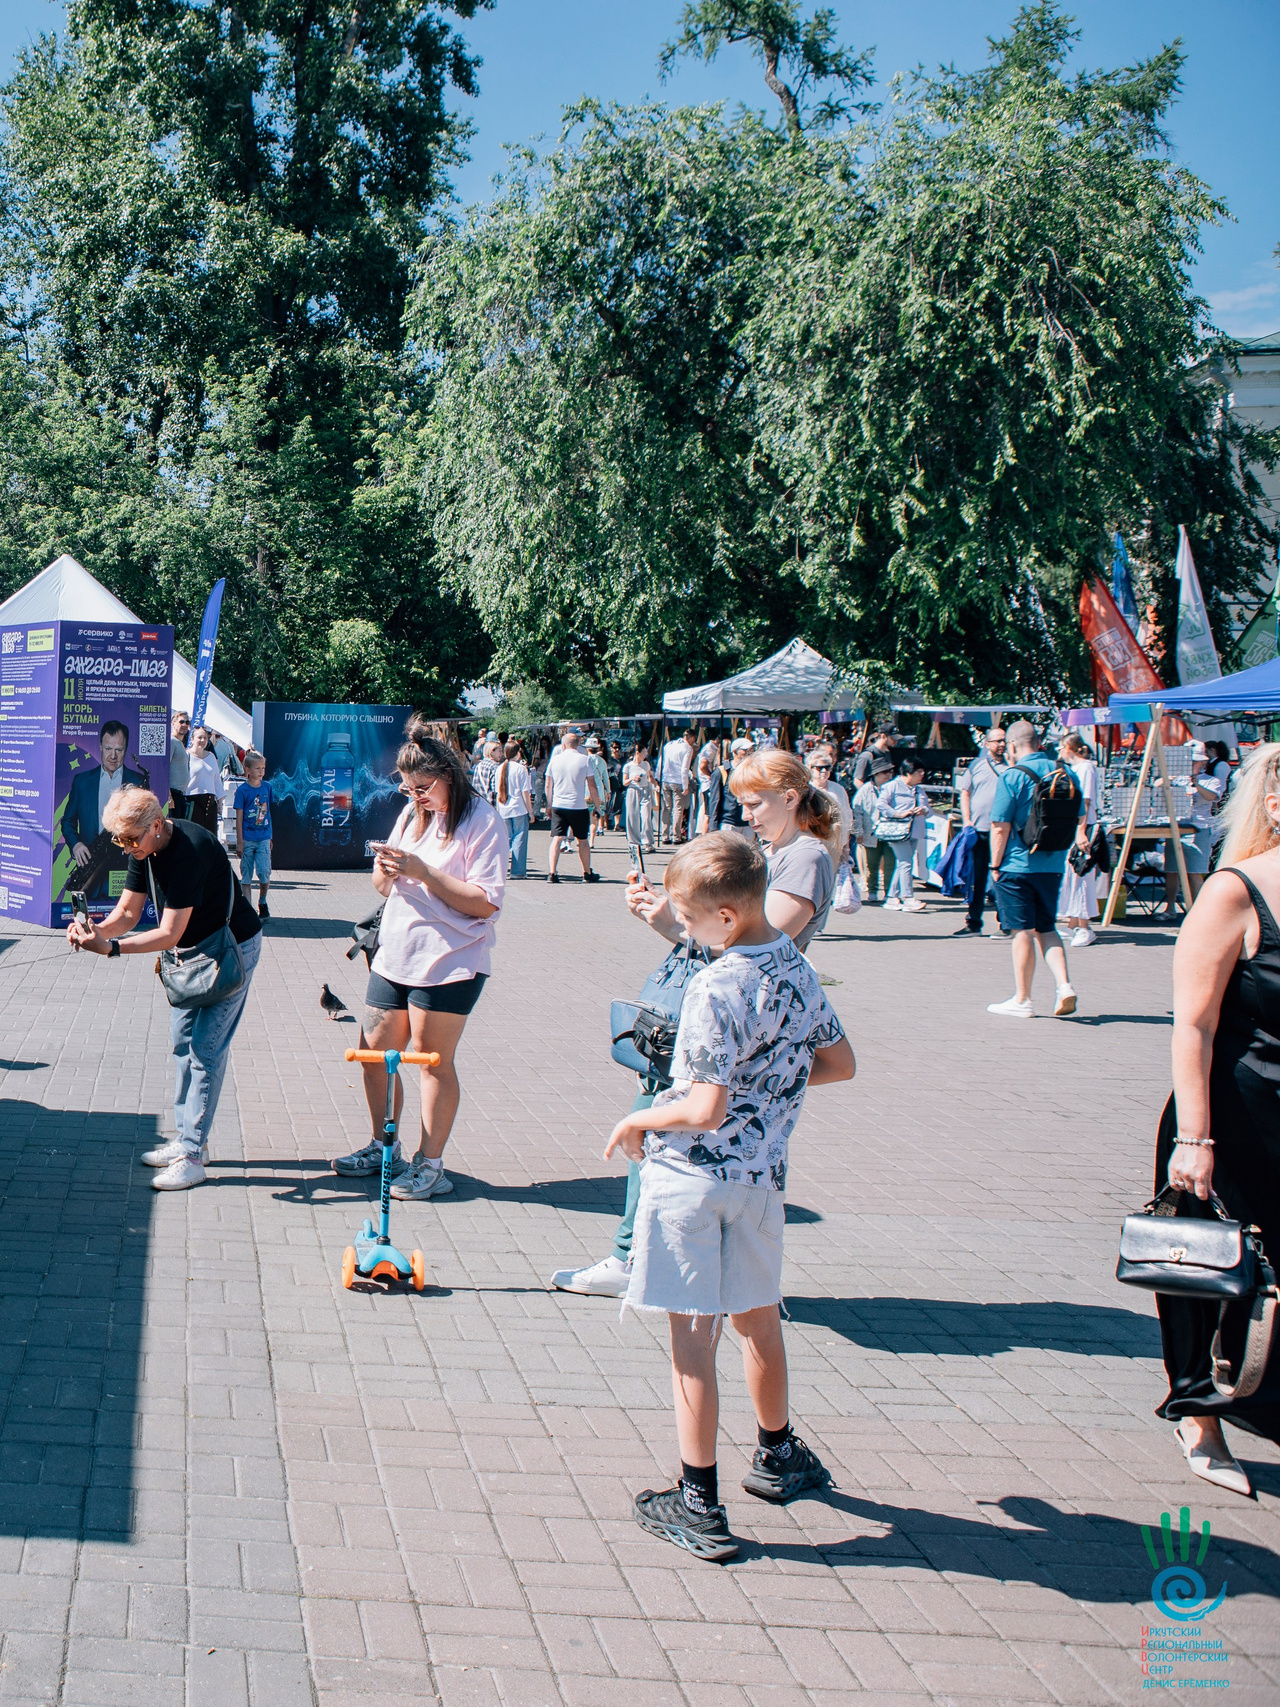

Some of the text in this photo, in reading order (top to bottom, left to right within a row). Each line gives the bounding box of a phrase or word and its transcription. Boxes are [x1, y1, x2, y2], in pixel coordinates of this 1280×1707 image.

[64, 678, 75, 700] 11
[64, 704, 92, 713] ИГОРЬ
[64, 714, 99, 724] БУТМАН
[284, 713, 394, 724] ГЛУБИНА, КОТОРУЮ СЛЫШНО
[322, 769, 336, 827] BAIKAL
